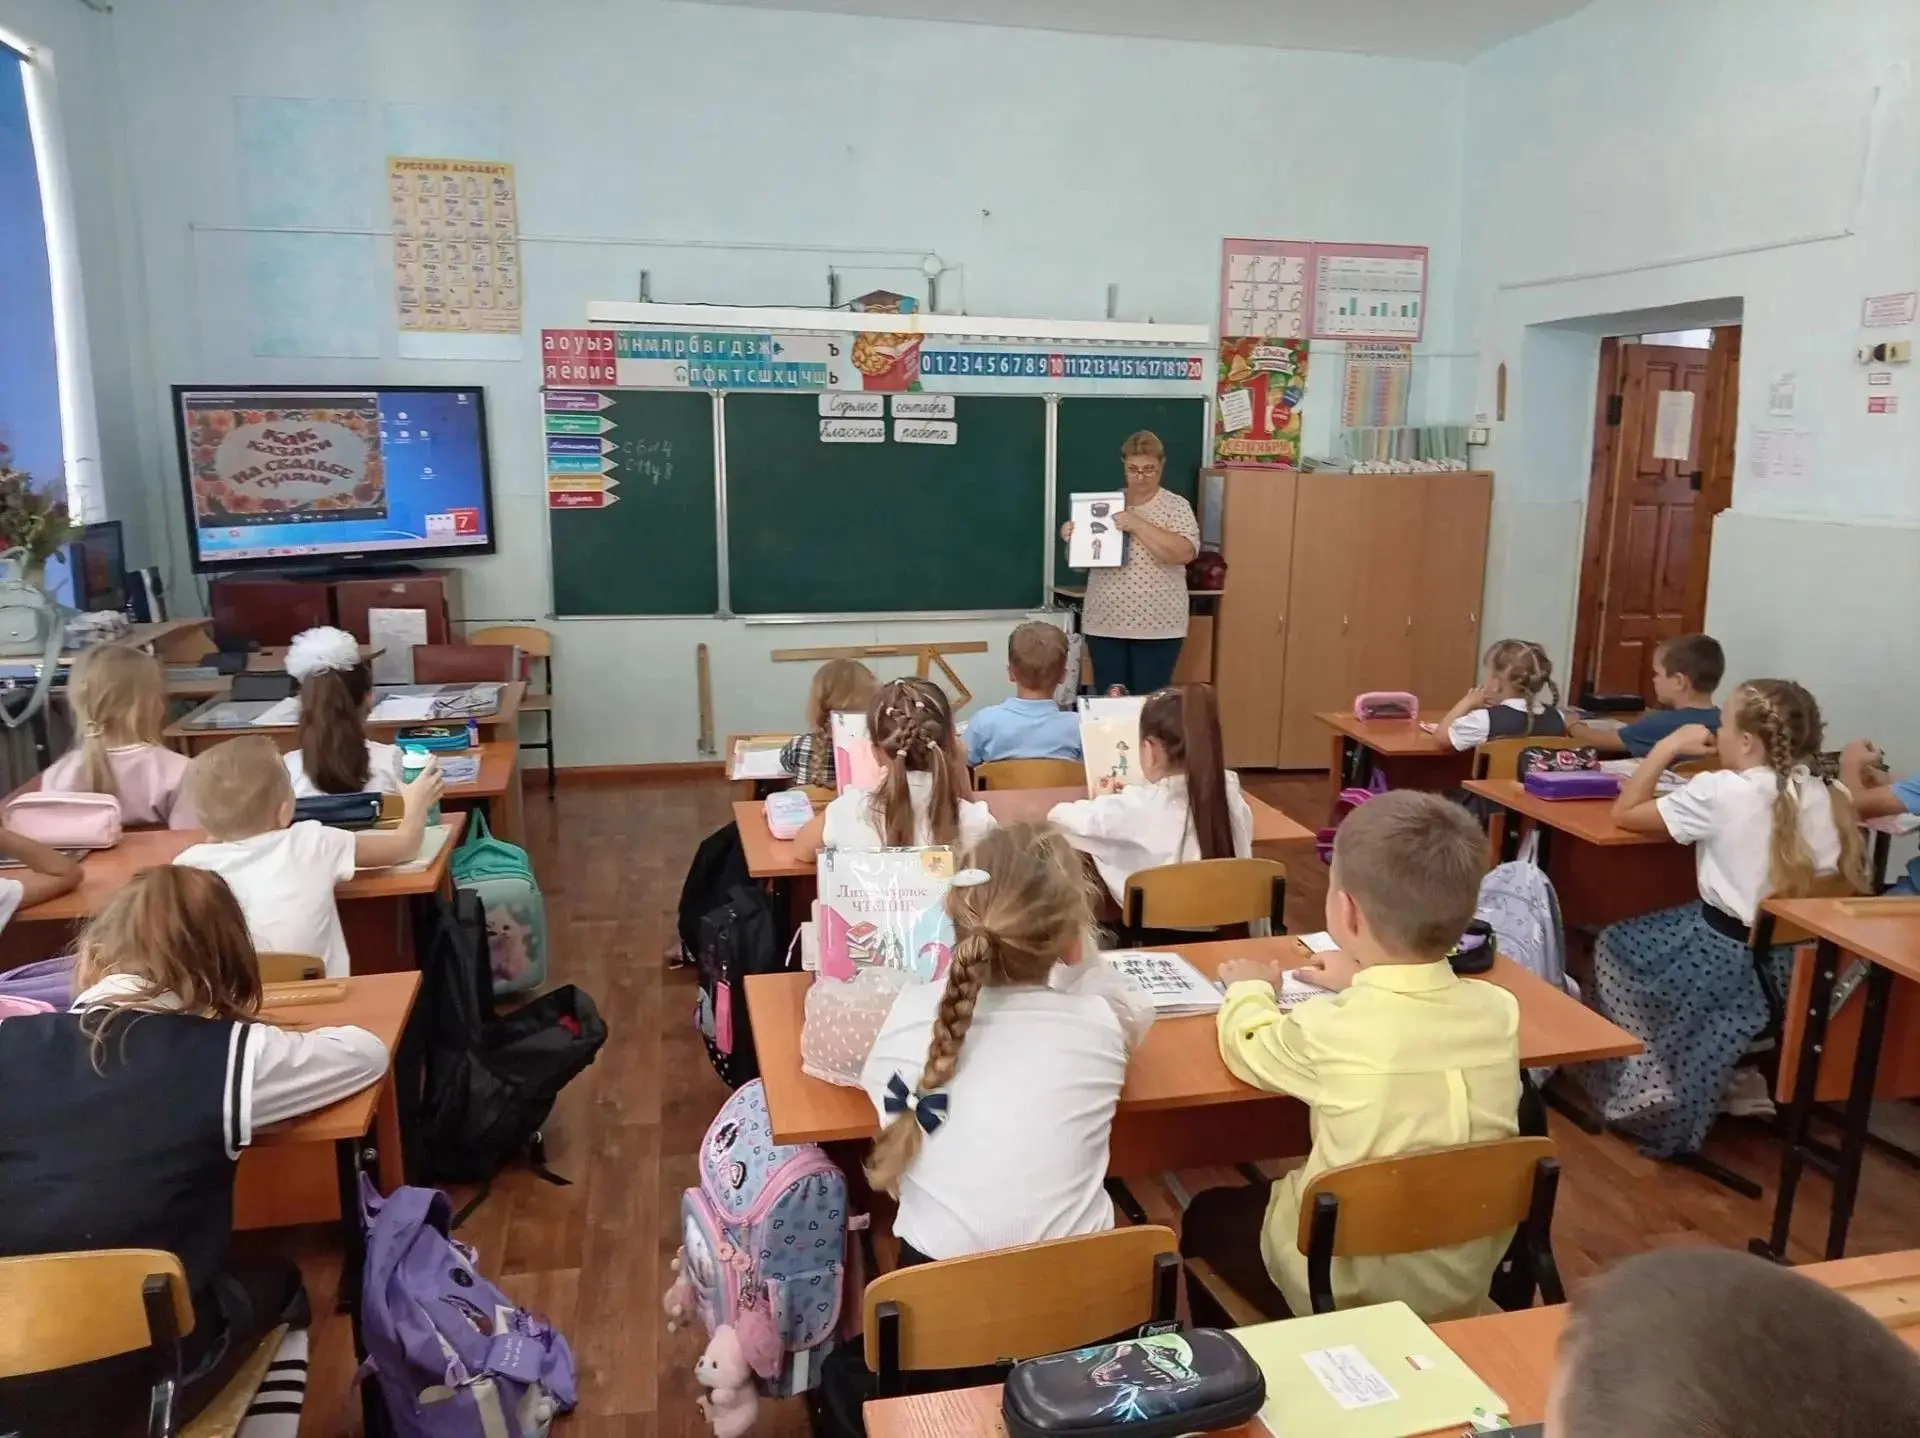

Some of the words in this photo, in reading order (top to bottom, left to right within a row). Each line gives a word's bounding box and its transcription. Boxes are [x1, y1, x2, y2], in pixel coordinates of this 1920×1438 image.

[922, 355, 931, 371] 0
[936, 355, 943, 372] 1
[949, 355, 957, 372] 2
[961, 356, 970, 372] 3
[974, 356, 983, 373] 4
[987, 357, 996, 373] 5
[1000, 357, 1009, 373] 6
[1013, 357, 1021, 373] 7
[1025, 358, 1034, 373] 8
[1039, 358, 1047, 374] 9
[1065, 358, 1076, 374] 11
[1079, 359, 1091, 375] 12
[1093, 359, 1105, 375] 13
[1107, 360, 1119, 375] 14
[1121, 360, 1133, 375] 15
[1135, 360, 1147, 376] 16
[1149, 360, 1161, 376] 17
[1162, 361, 1175, 376] 18
[1176, 361, 1188, 377] 19
